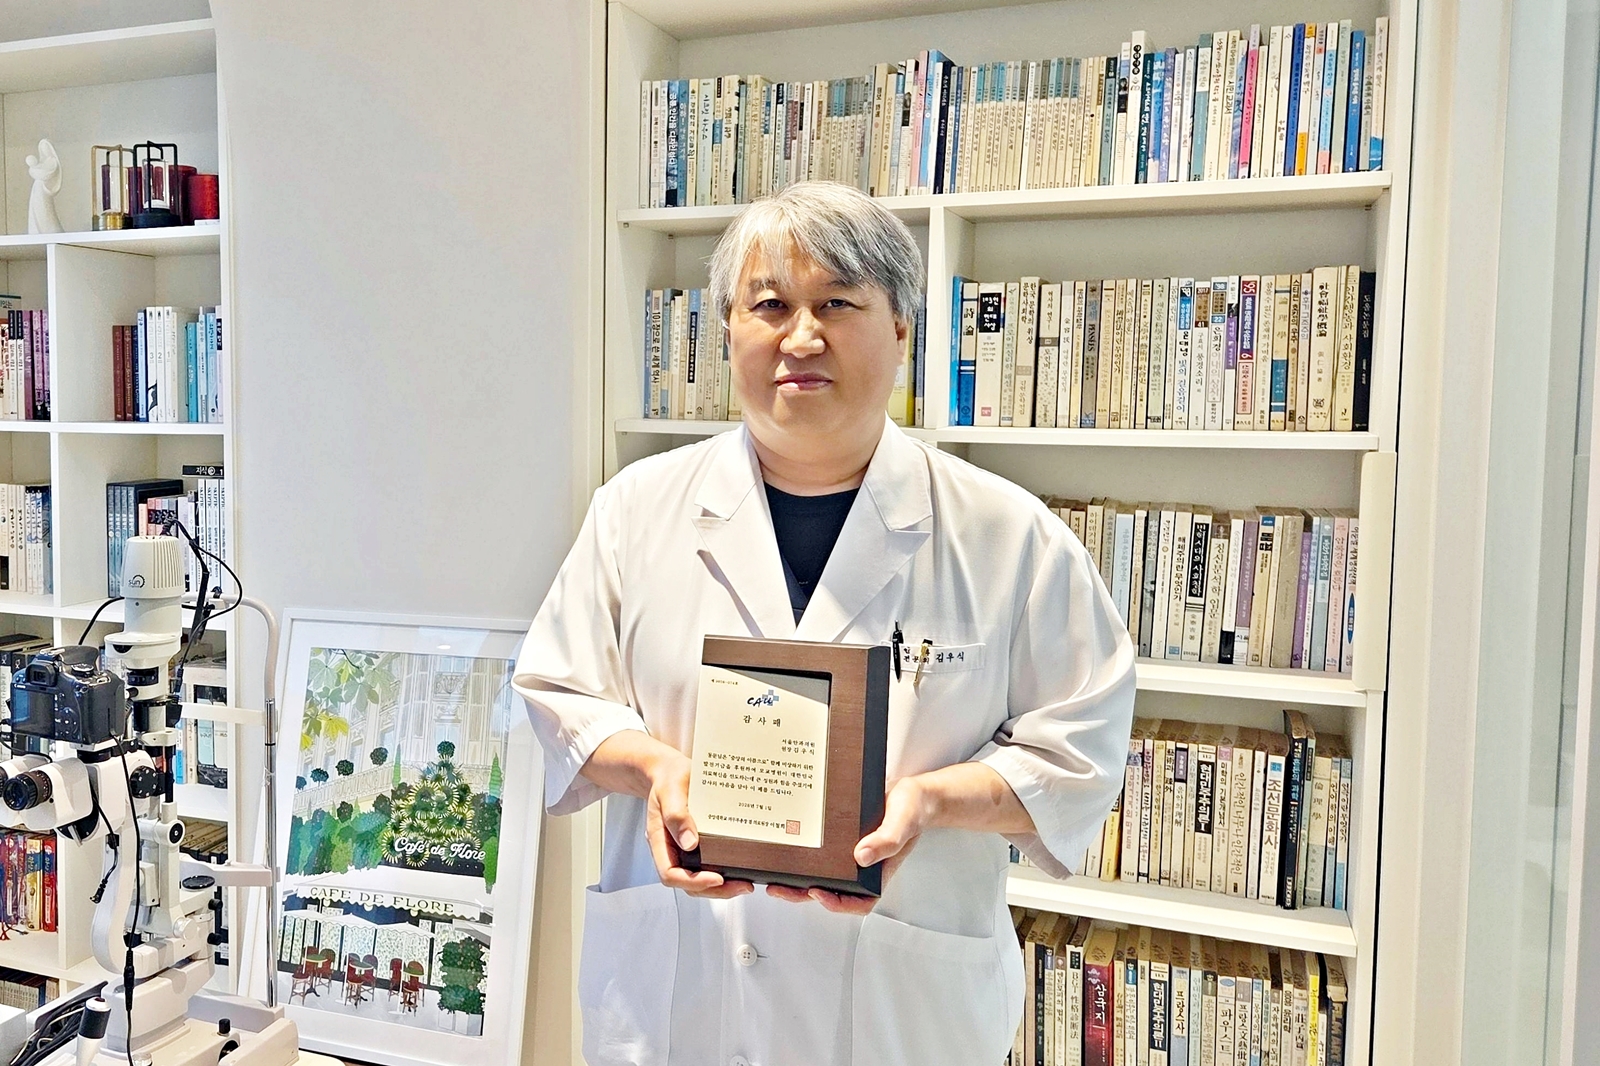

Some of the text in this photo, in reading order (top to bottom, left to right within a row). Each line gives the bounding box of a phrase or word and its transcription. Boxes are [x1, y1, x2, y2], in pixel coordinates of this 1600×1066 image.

[701, 94, 710, 140] 시크릿 하우스
[1030, 282, 1036, 298] 한국
[983, 322, 996, 331] 사상
[651, 345, 660, 354] 쓴
[651, 354, 660, 369] 세계
[651, 369, 660, 384] 역사
[1173, 572, 1183, 602] 무엇인가
[936, 651, 964, 663] 김우식
[747, 697, 772, 708] CAU
[702, 770, 728, 779] 의료혁신을
[790, 771, 813, 780] 대한민국
[1220, 762, 1228, 785] 미학의
[701, 778, 718, 787] 감사의
[719, 781, 735, 789] 마음을
[737, 783, 748, 791] 담아
[770, 788, 794, 797] 드립니다.
[1264, 779, 1281, 850] 조선문화사
[430, 844, 445, 856] de
[449, 842, 486, 860] Flore
[310, 887, 455, 912] CAFE DE FLORE
[1094, 983, 1107, 1025] 삼국지
[1175, 990, 1185, 1034] 프랑스사
[1219, 1008, 1233, 1054] 파우스트
[1331, 1036, 1343, 1061] ART
